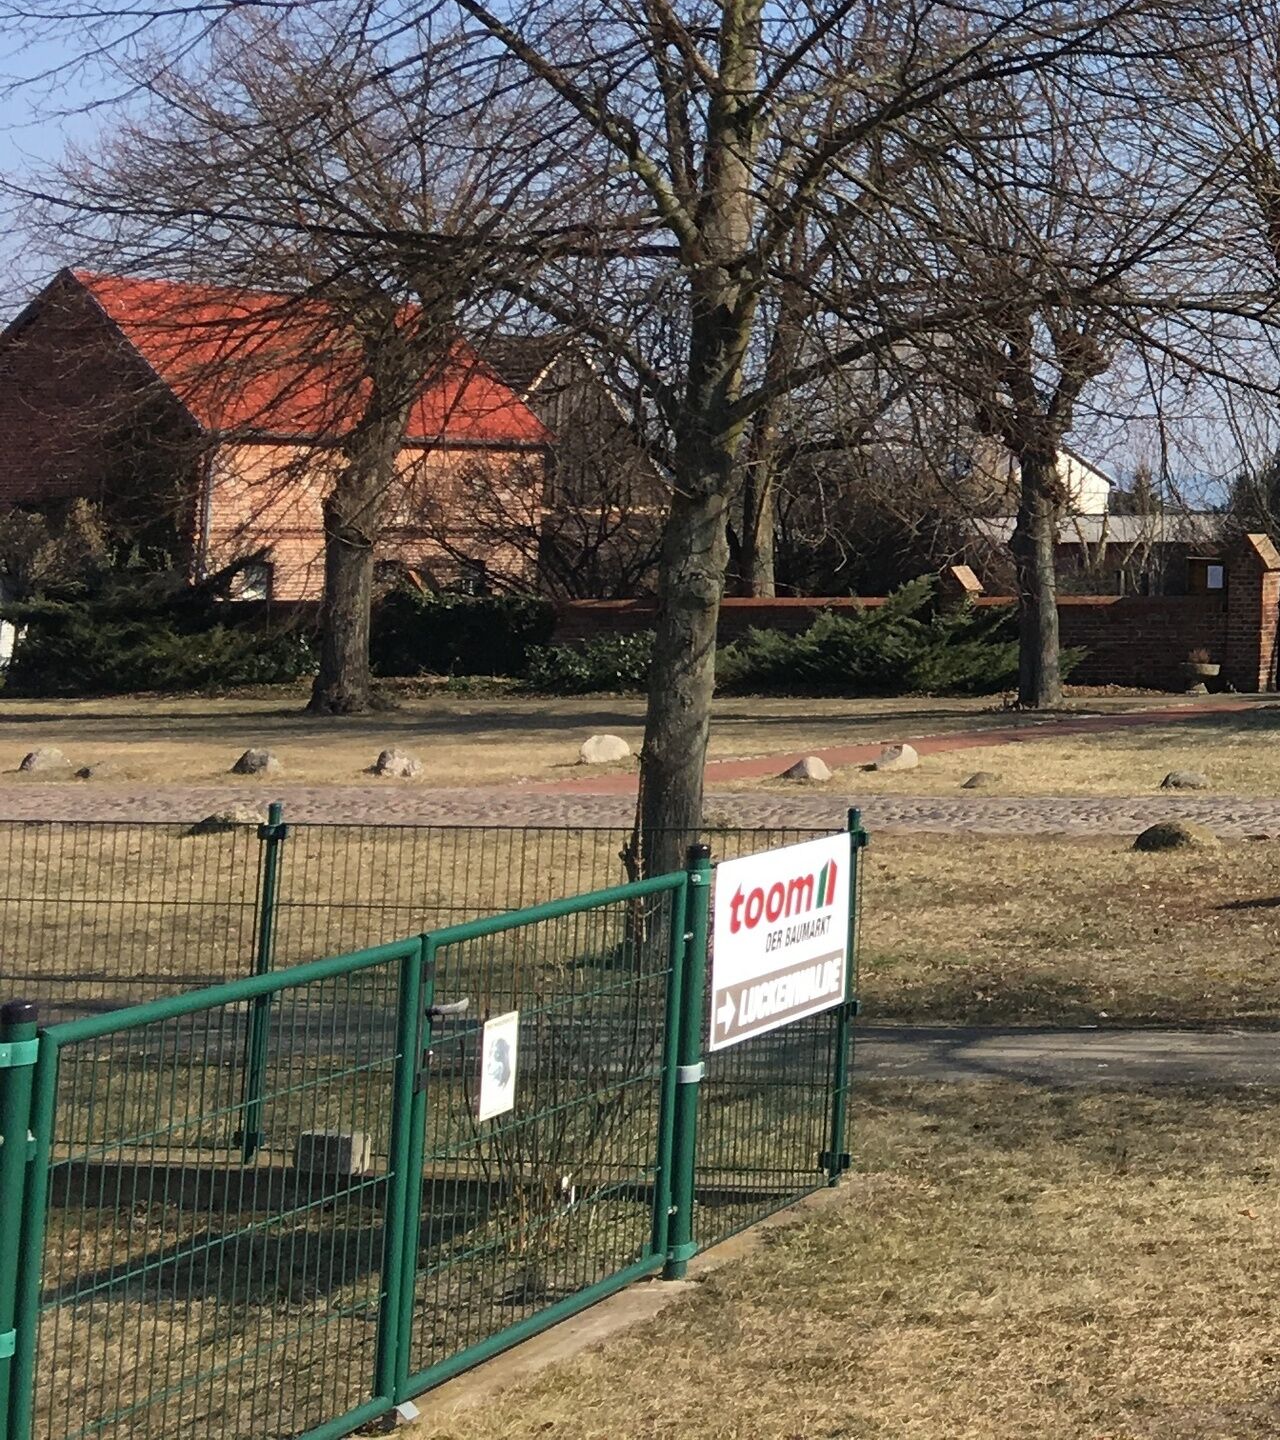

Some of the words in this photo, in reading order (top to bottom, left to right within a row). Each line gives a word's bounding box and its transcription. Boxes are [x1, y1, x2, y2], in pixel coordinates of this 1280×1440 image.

[729, 872, 814, 935] toom
[765, 929, 783, 953] DER
[785, 914, 832, 947] BAUMARKT
[738, 957, 842, 1027] LUCKENWALDE
